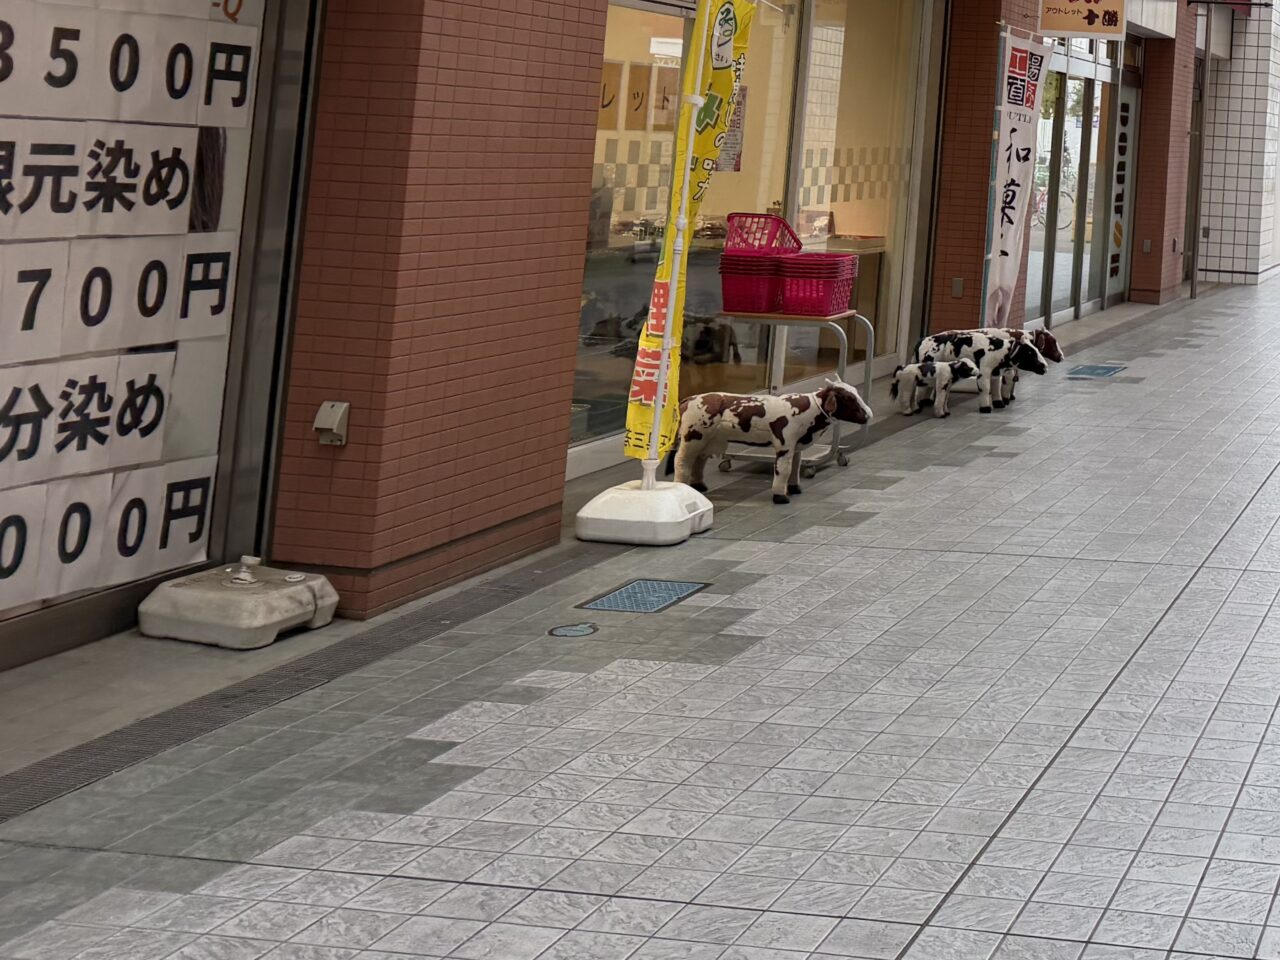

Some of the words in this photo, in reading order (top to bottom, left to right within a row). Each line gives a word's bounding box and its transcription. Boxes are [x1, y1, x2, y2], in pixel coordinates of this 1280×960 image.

[1046, 7, 1082, 16] アウトレット
[999, 127, 1032, 258] 和菓
[0, 373, 165, 462] 分染め
